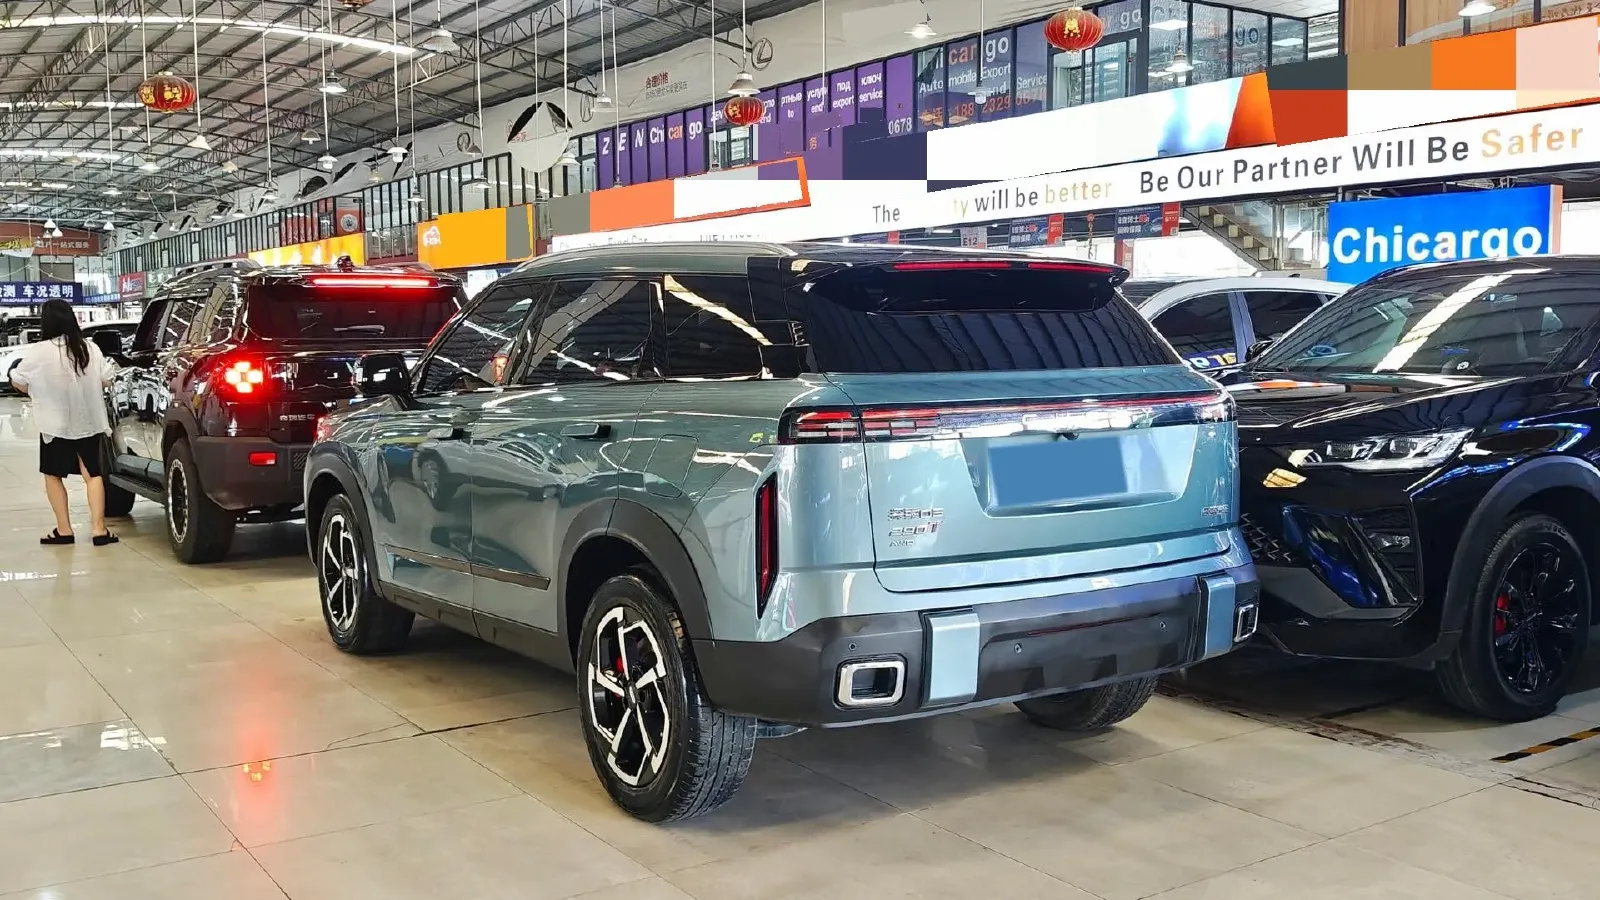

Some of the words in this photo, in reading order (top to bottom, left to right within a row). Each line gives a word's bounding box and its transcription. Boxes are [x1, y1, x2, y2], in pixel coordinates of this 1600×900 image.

[1016, 72, 1047, 90] Service
[888, 116, 913, 136] 0678
[872, 204, 901, 225] The
[974, 188, 1009, 213] will
[1015, 186, 1039, 208] be
[1044, 180, 1113, 205] better
[1139, 170, 1169, 194] Be
[1176, 165, 1224, 189] Our
[1233, 152, 1343, 184] Partner
[1352, 139, 1415, 172] Will
[1426, 136, 1470, 165] Be
[1480, 122, 1584, 159] Safer
[963, 237, 978, 248] E12
[22, 284, 74, 298] 车况透明
